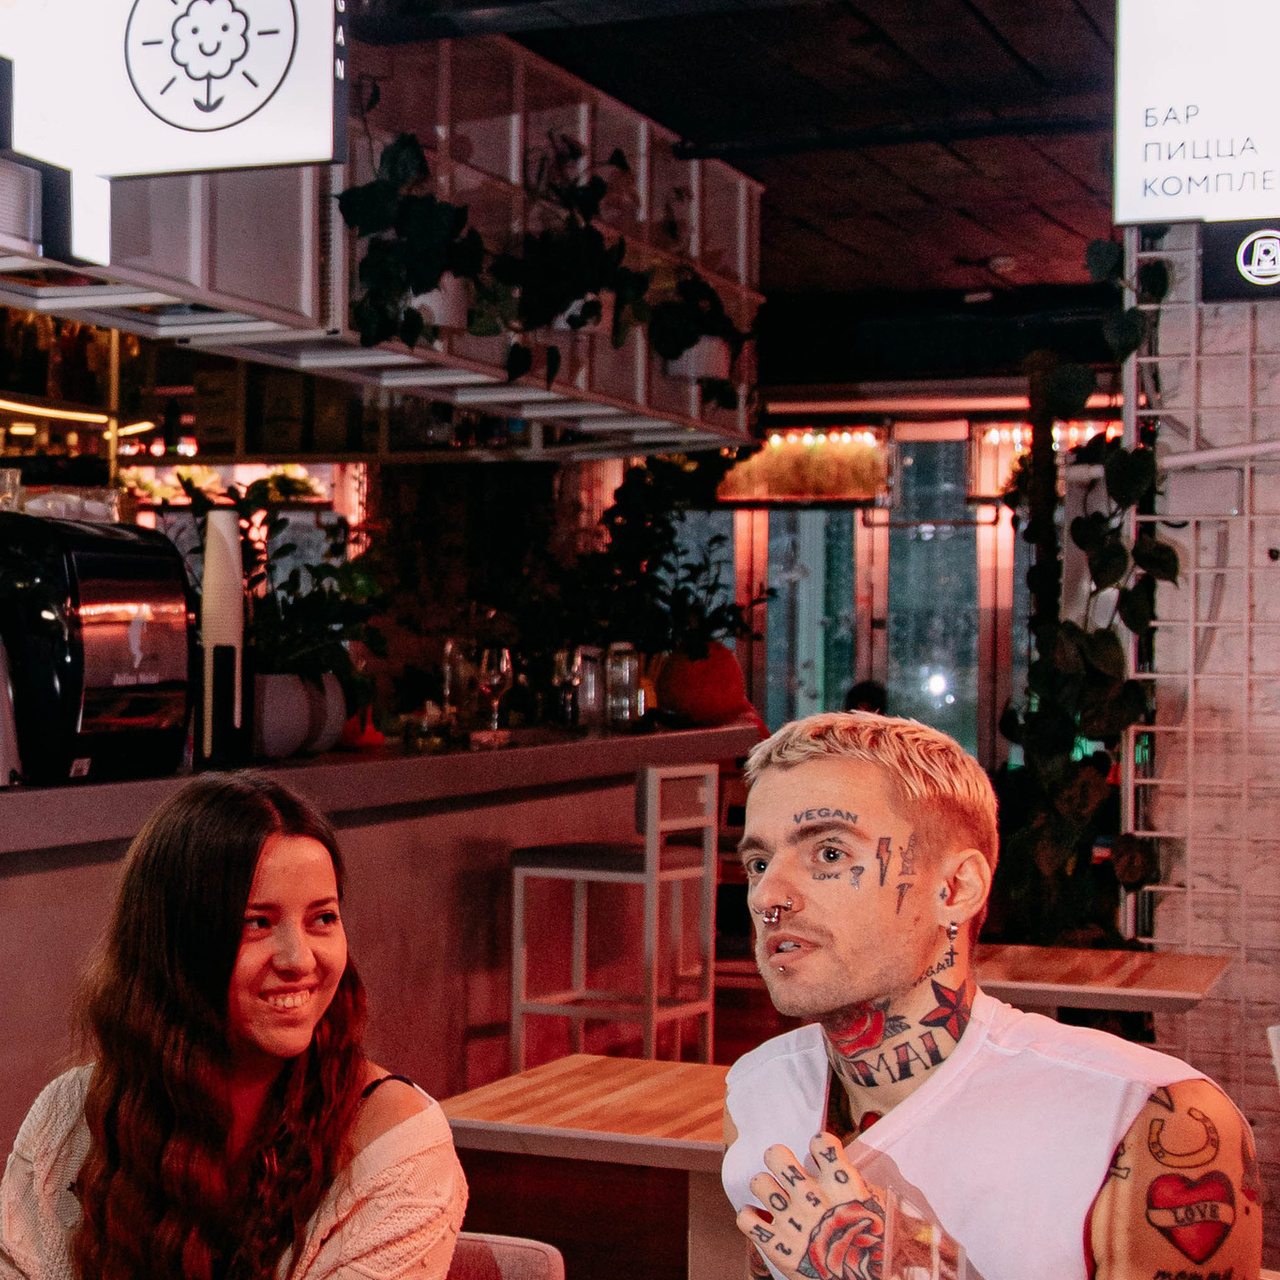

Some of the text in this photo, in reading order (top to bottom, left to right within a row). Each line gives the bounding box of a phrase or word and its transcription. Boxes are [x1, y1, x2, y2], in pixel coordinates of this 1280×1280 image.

[1145, 104, 1200, 128] БАР
[1144, 136, 1258, 163] ПИЦЦА
[793, 807, 859, 824] VEGAN
[1174, 1203, 1220, 1224] LOVE
